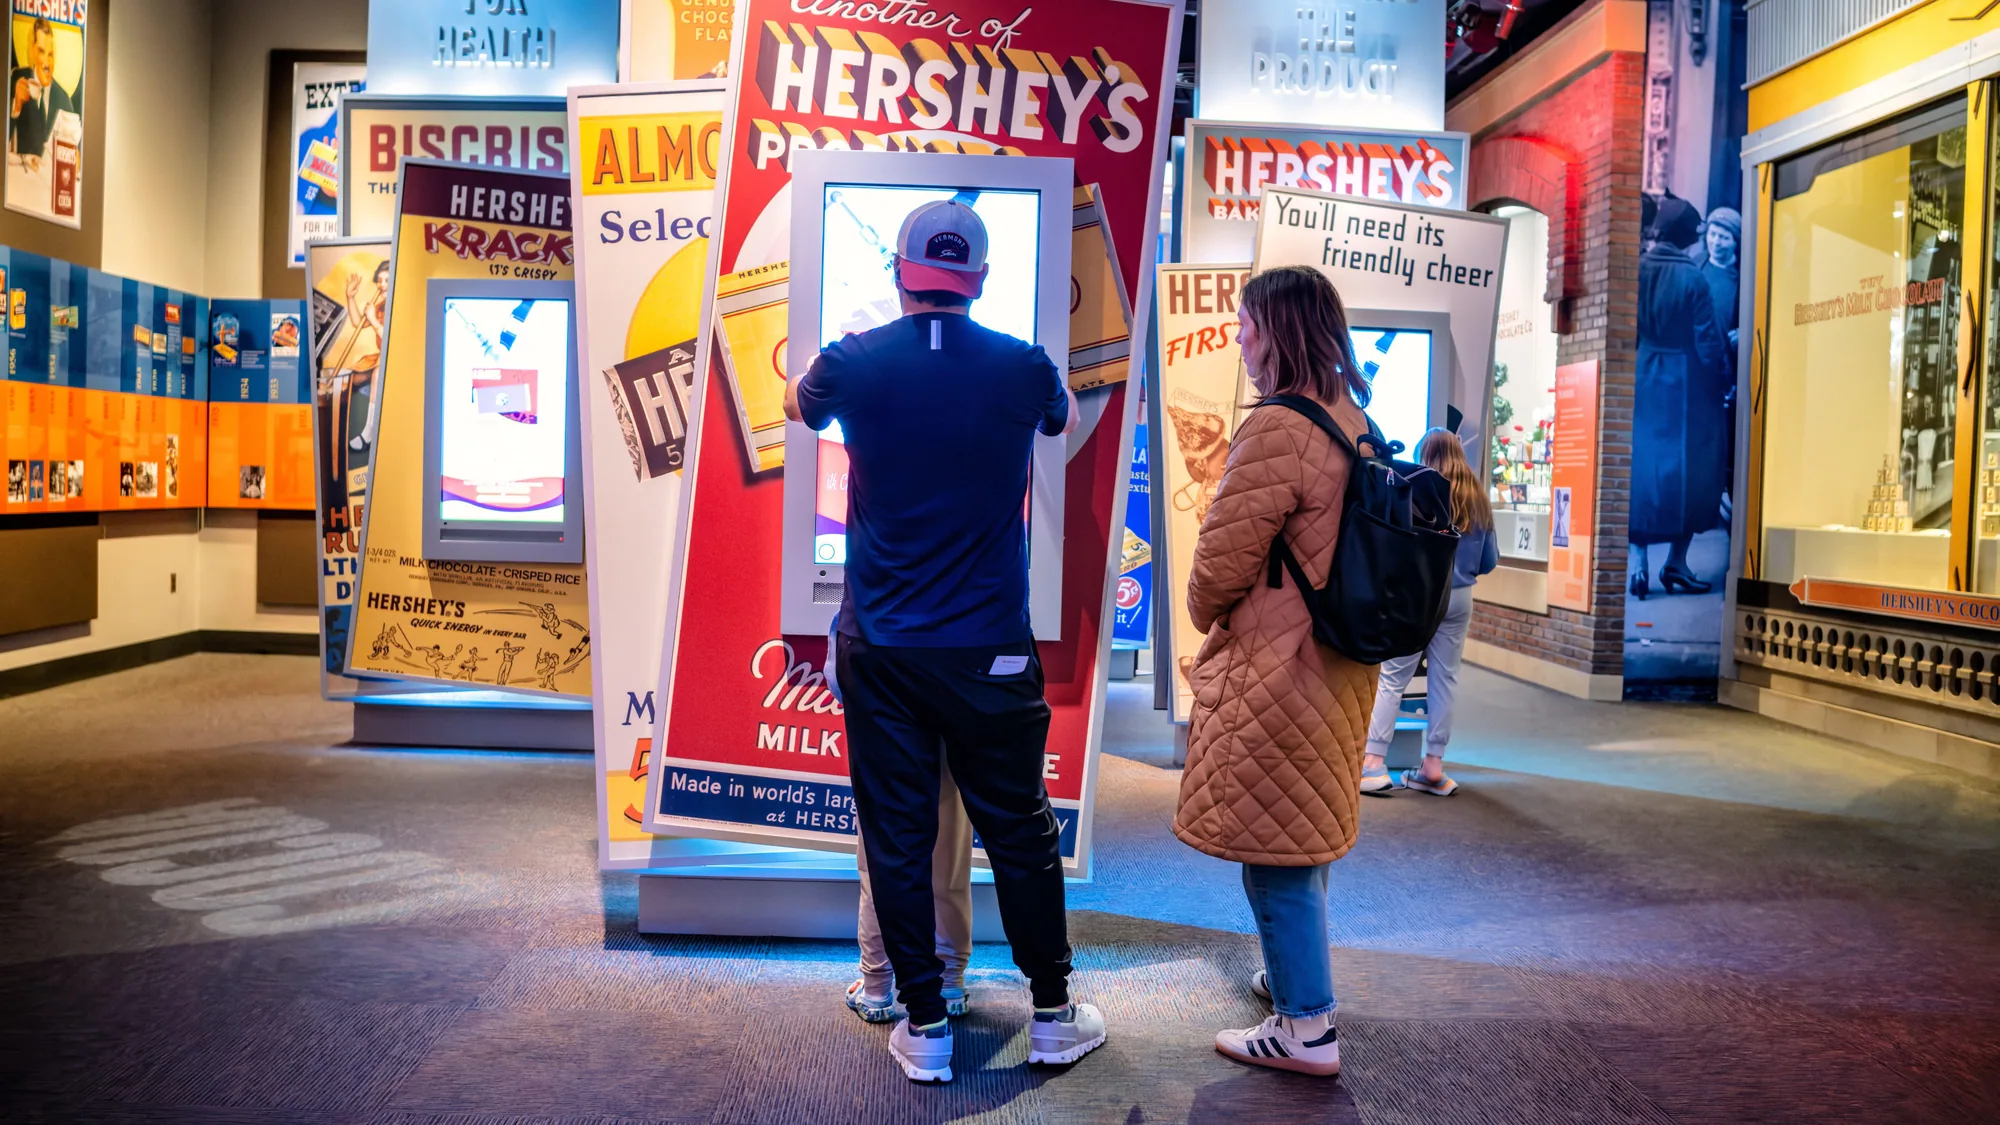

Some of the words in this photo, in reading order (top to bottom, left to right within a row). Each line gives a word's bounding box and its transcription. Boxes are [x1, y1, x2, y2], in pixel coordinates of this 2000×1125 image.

[680, 10, 735, 24] CHOC
[979, 7, 1033, 59] of
[1296, 8, 1356, 53] THE
[432, 25, 556, 68] HEALTH
[756, 20, 1150, 153] HERSHEY'S
[1251, 52, 1398, 99] PRODUCT
[1204, 136, 1455, 206] HERSHEY'S
[450, 184, 573, 226] HERSHE
[1275, 195, 1337, 232] You'll
[1346, 214, 1407, 242] need
[1416, 216, 1445, 247] its
[933, 234, 966, 248] VERMONT
[489, 264, 509, 276] IT'S
[514, 266, 558, 281] CRISPY
[738, 261, 790, 279] HERSHE
[1322, 237, 1415, 286] friendly
[1426, 254, 1494, 288] cheer
[1795, 295, 1845, 327] HERSHEY'S
[1846, 290, 1873, 317] MILK
[1875, 277, 1946, 312] CHOCOLATE
[399, 556, 425, 568] MILK
[428, 559, 497, 577] CHOCOLATE
[503, 568, 552, 583] CRISPED
[554, 573, 581, 585] RICE
[367, 591, 466, 618] HERSHEY'S
[1881, 592, 1955, 615] HERSHEY'S
[410, 618, 443, 630] QUICK
[443, 622, 483, 634] ENERGY
[756, 722, 842, 758] MILK
[671, 772, 722, 795] Made
[729, 778, 744, 797] in
[752, 784, 816, 805] world's
[766, 810, 786, 823] at
